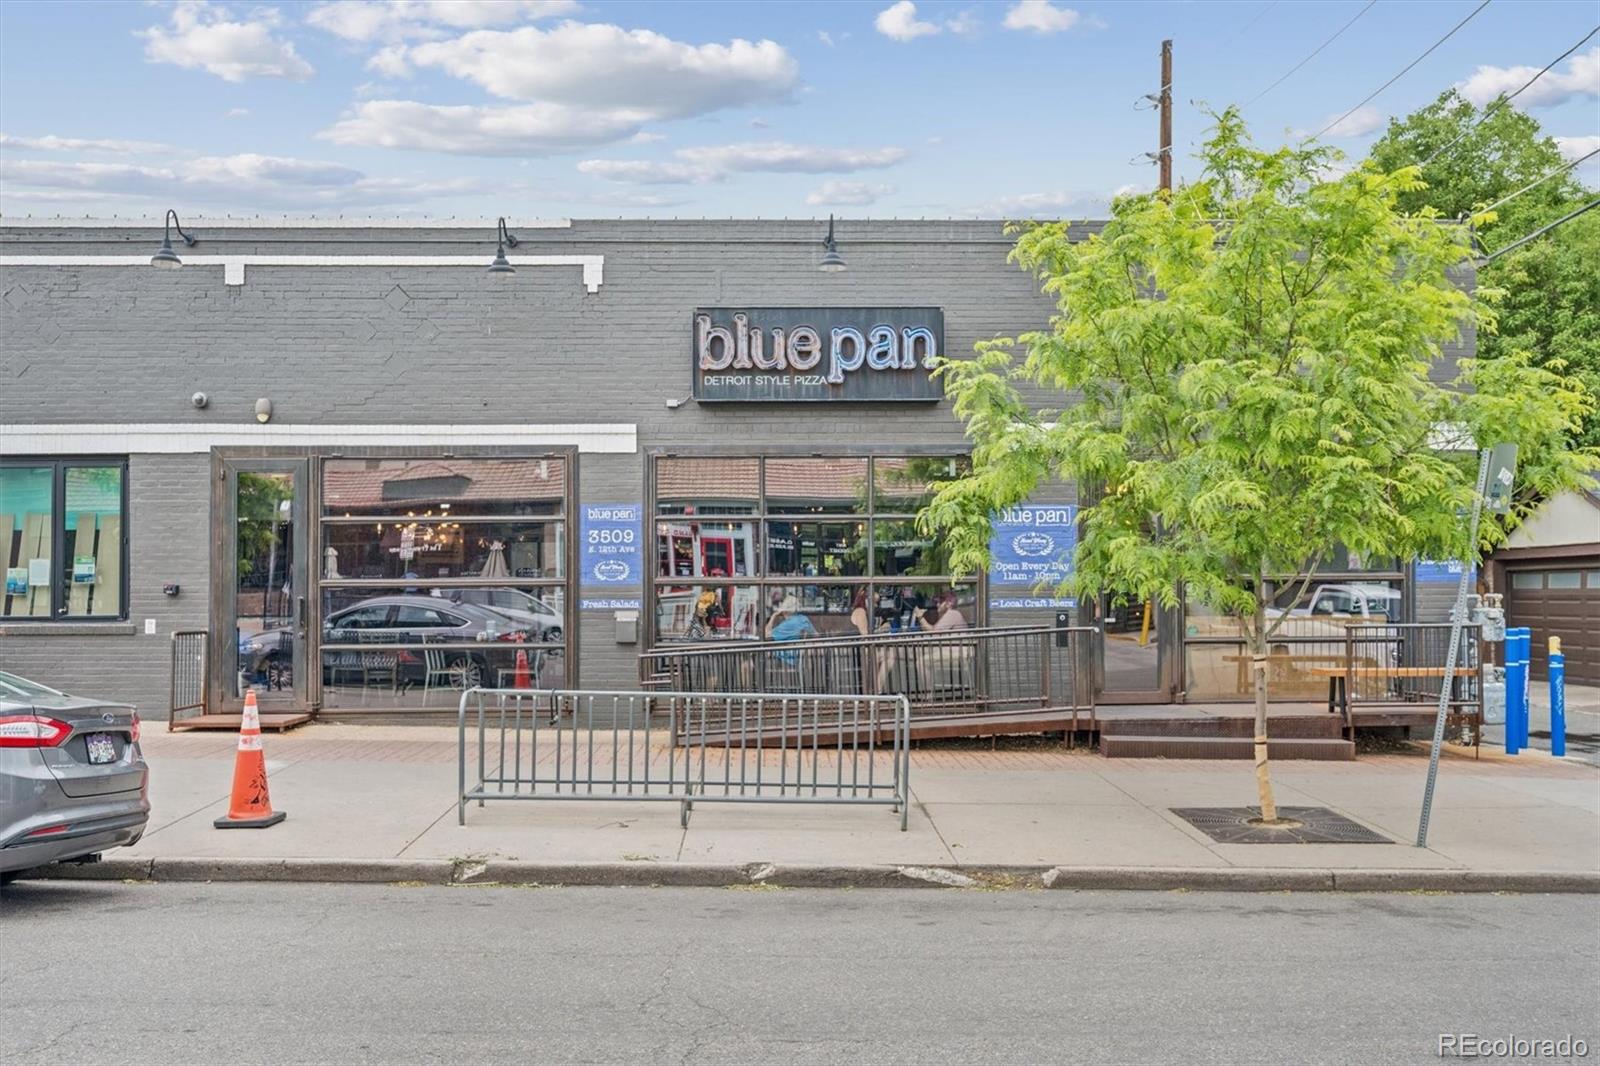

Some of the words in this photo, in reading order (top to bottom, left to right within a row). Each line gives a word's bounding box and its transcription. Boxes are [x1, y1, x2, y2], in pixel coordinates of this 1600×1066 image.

[697, 313, 822, 371] blue
[828, 325, 939, 384] pan
[704, 375, 751, 386] DETROIT
[755, 375, 790, 386] STYLE
[794, 375, 828, 386] PIZZA
[588, 508, 612, 519] blue
[612, 510, 633, 521] pan
[1035, 510, 1067, 526] pan
[588, 529, 634, 544] 3509
[995, 562, 1019, 571] Open
[1022, 562, 1050, 572] Every
[1052, 562, 1069, 571] Day
[1003, 572, 1027, 580] 11am
[583, 600, 608, 608] Fresh
[610, 600, 639, 608] Salads
[1000, 599, 1023, 608] Local
[1025, 599, 1048, 608] Craft
[1049, 599, 1074, 608] Beers
